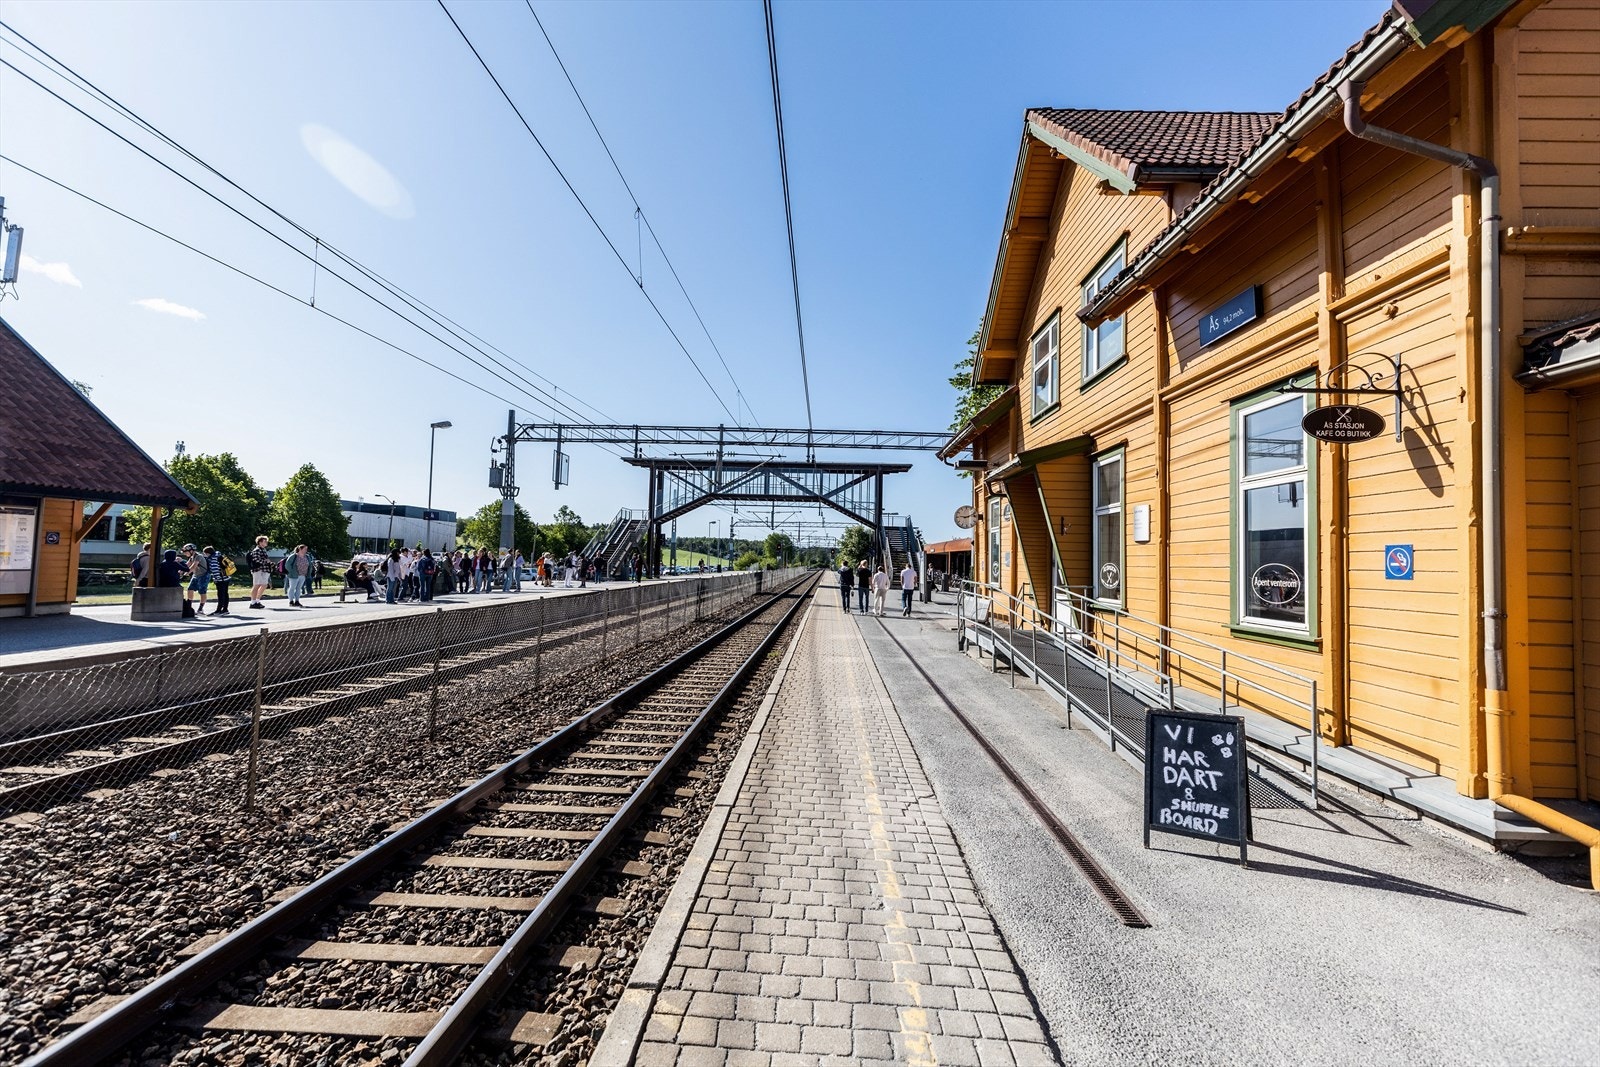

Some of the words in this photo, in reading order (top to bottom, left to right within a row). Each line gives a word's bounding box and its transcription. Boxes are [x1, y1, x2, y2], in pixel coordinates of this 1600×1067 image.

[1209, 315, 1220, 333] Ås
[1324, 421, 1333, 429] ÅS
[1347, 430, 1371, 438] BUTIKK
[1164, 724, 1194, 745] VI
[1163, 746, 1211, 768] HAR
[1163, 766, 1224, 791] DART
[1184, 787, 1195, 800] &
[1170, 798, 1230, 819] SHUFFLE
[1160, 807, 1219, 835] BOARD
